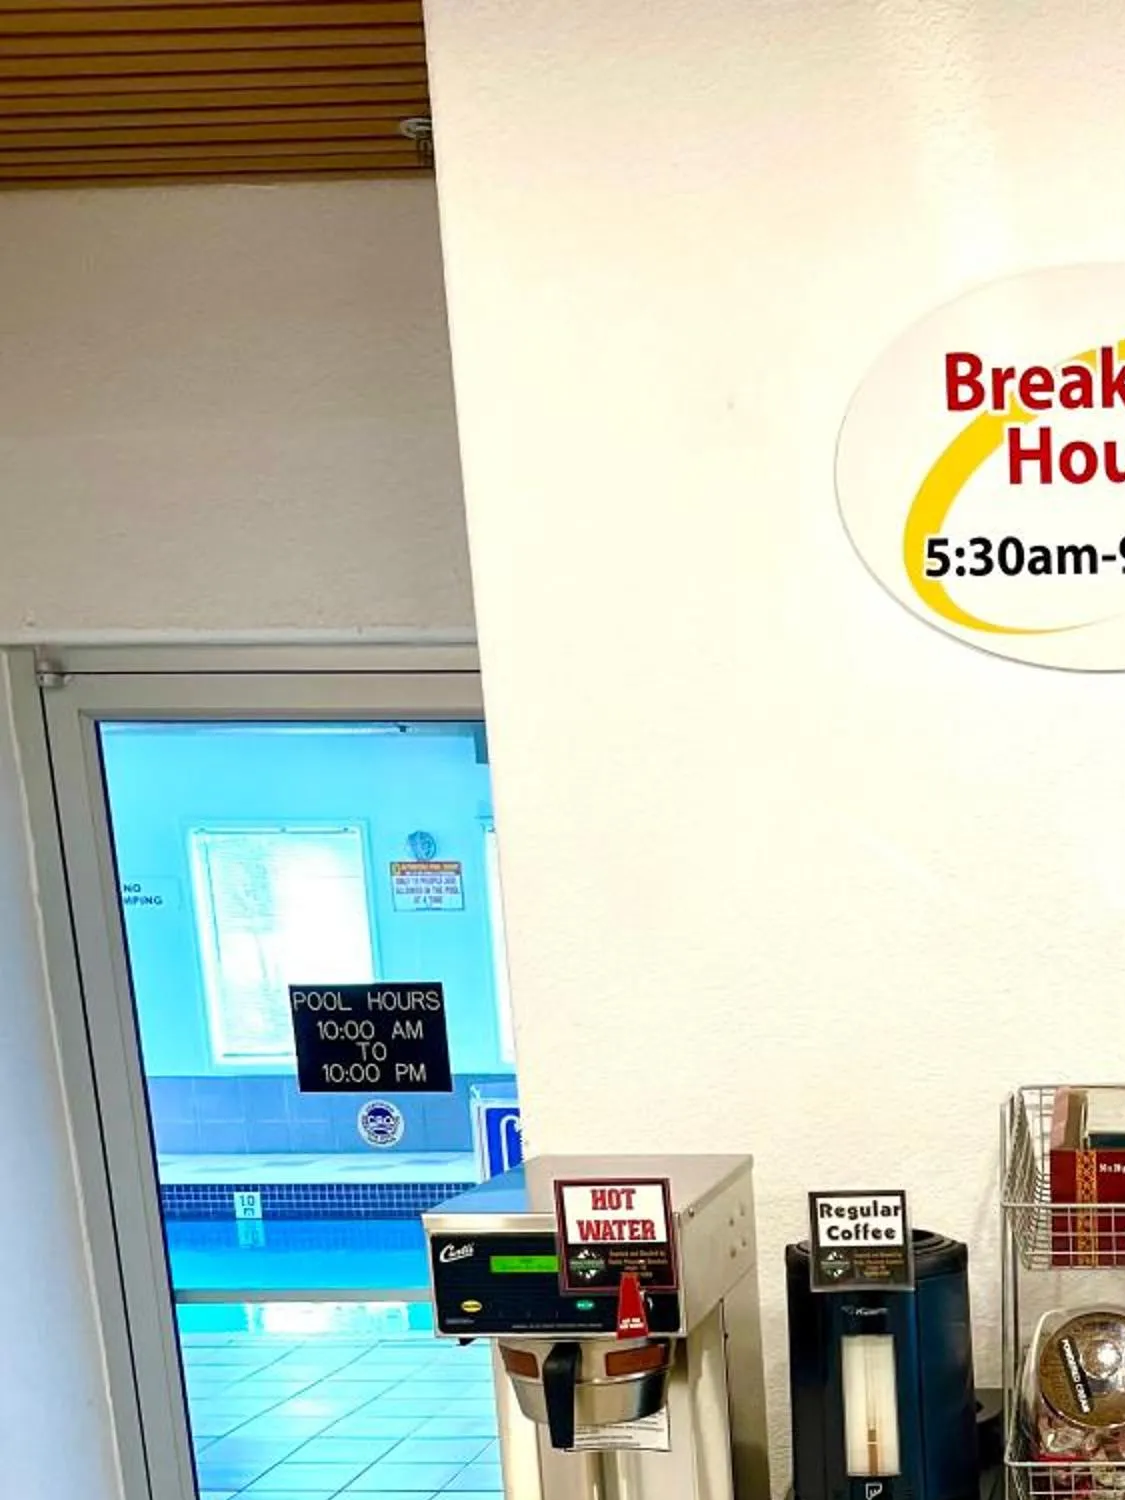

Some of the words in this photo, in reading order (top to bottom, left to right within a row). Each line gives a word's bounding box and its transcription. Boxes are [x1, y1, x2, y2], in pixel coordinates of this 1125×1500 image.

[123, 883, 141, 893] NO
[292, 991, 353, 1011] POOL
[367, 990, 441, 1011] HOURS
[316, 1019, 376, 1041] 10:00
[391, 1019, 424, 1040] AM
[355, 1041, 388, 1062] TO
[321, 1062, 381, 1083] 10:00
[395, 1062, 428, 1083] PM
[590, 1187, 637, 1211] HOT
[819, 1199, 901, 1221] Regular
[575, 1218, 657, 1242] WATER
[826, 1222, 897, 1241] Coffee
